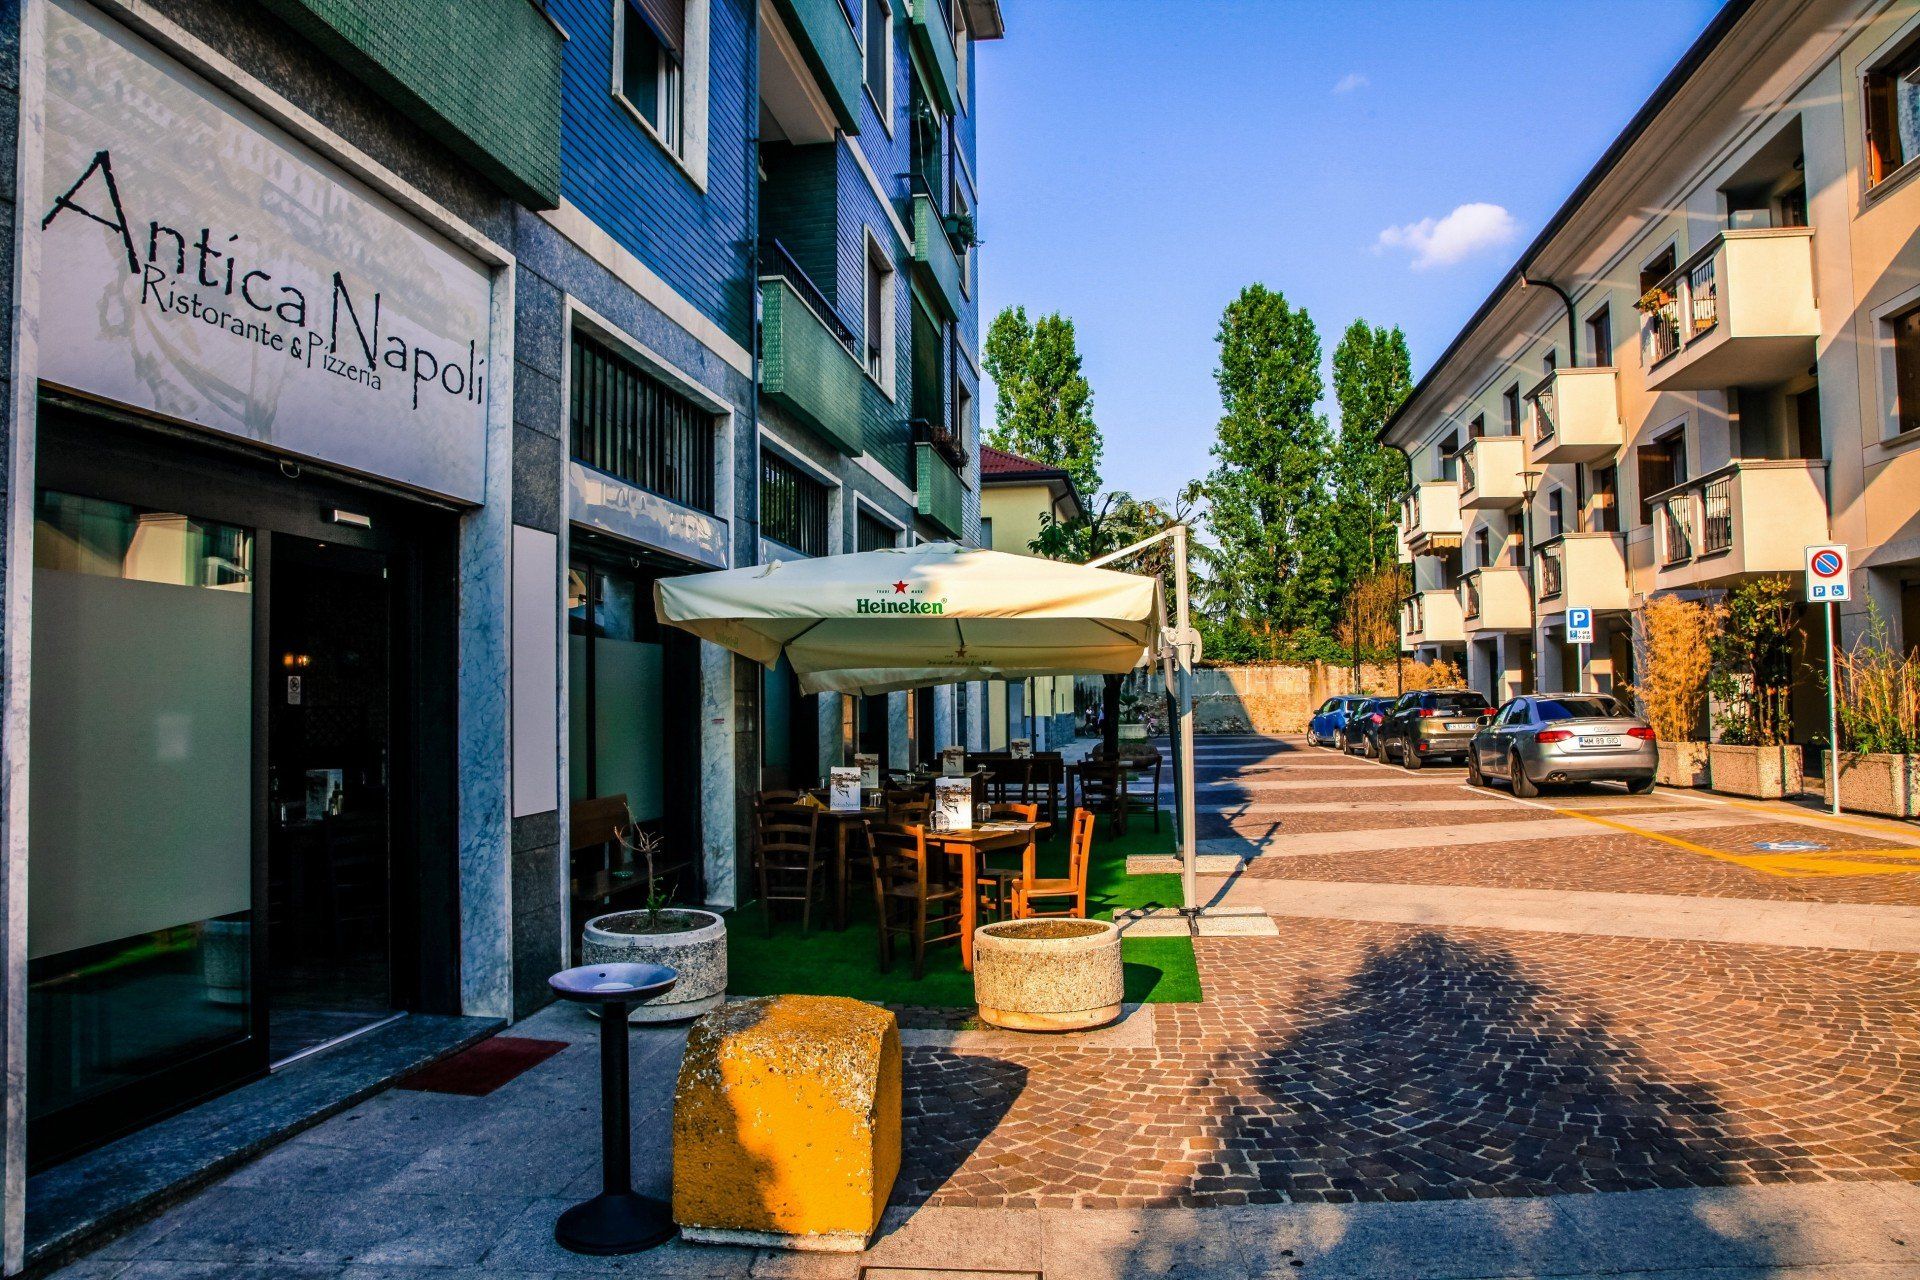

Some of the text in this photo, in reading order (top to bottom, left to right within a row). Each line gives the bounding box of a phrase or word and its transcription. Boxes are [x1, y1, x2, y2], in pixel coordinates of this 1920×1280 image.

[41, 150, 484, 410] Antica Napoli
[141, 264, 381, 391] Ristorante & Pizzeria
[856, 598, 944, 614] Heineken
[1573, 611, 1586, 626] P
